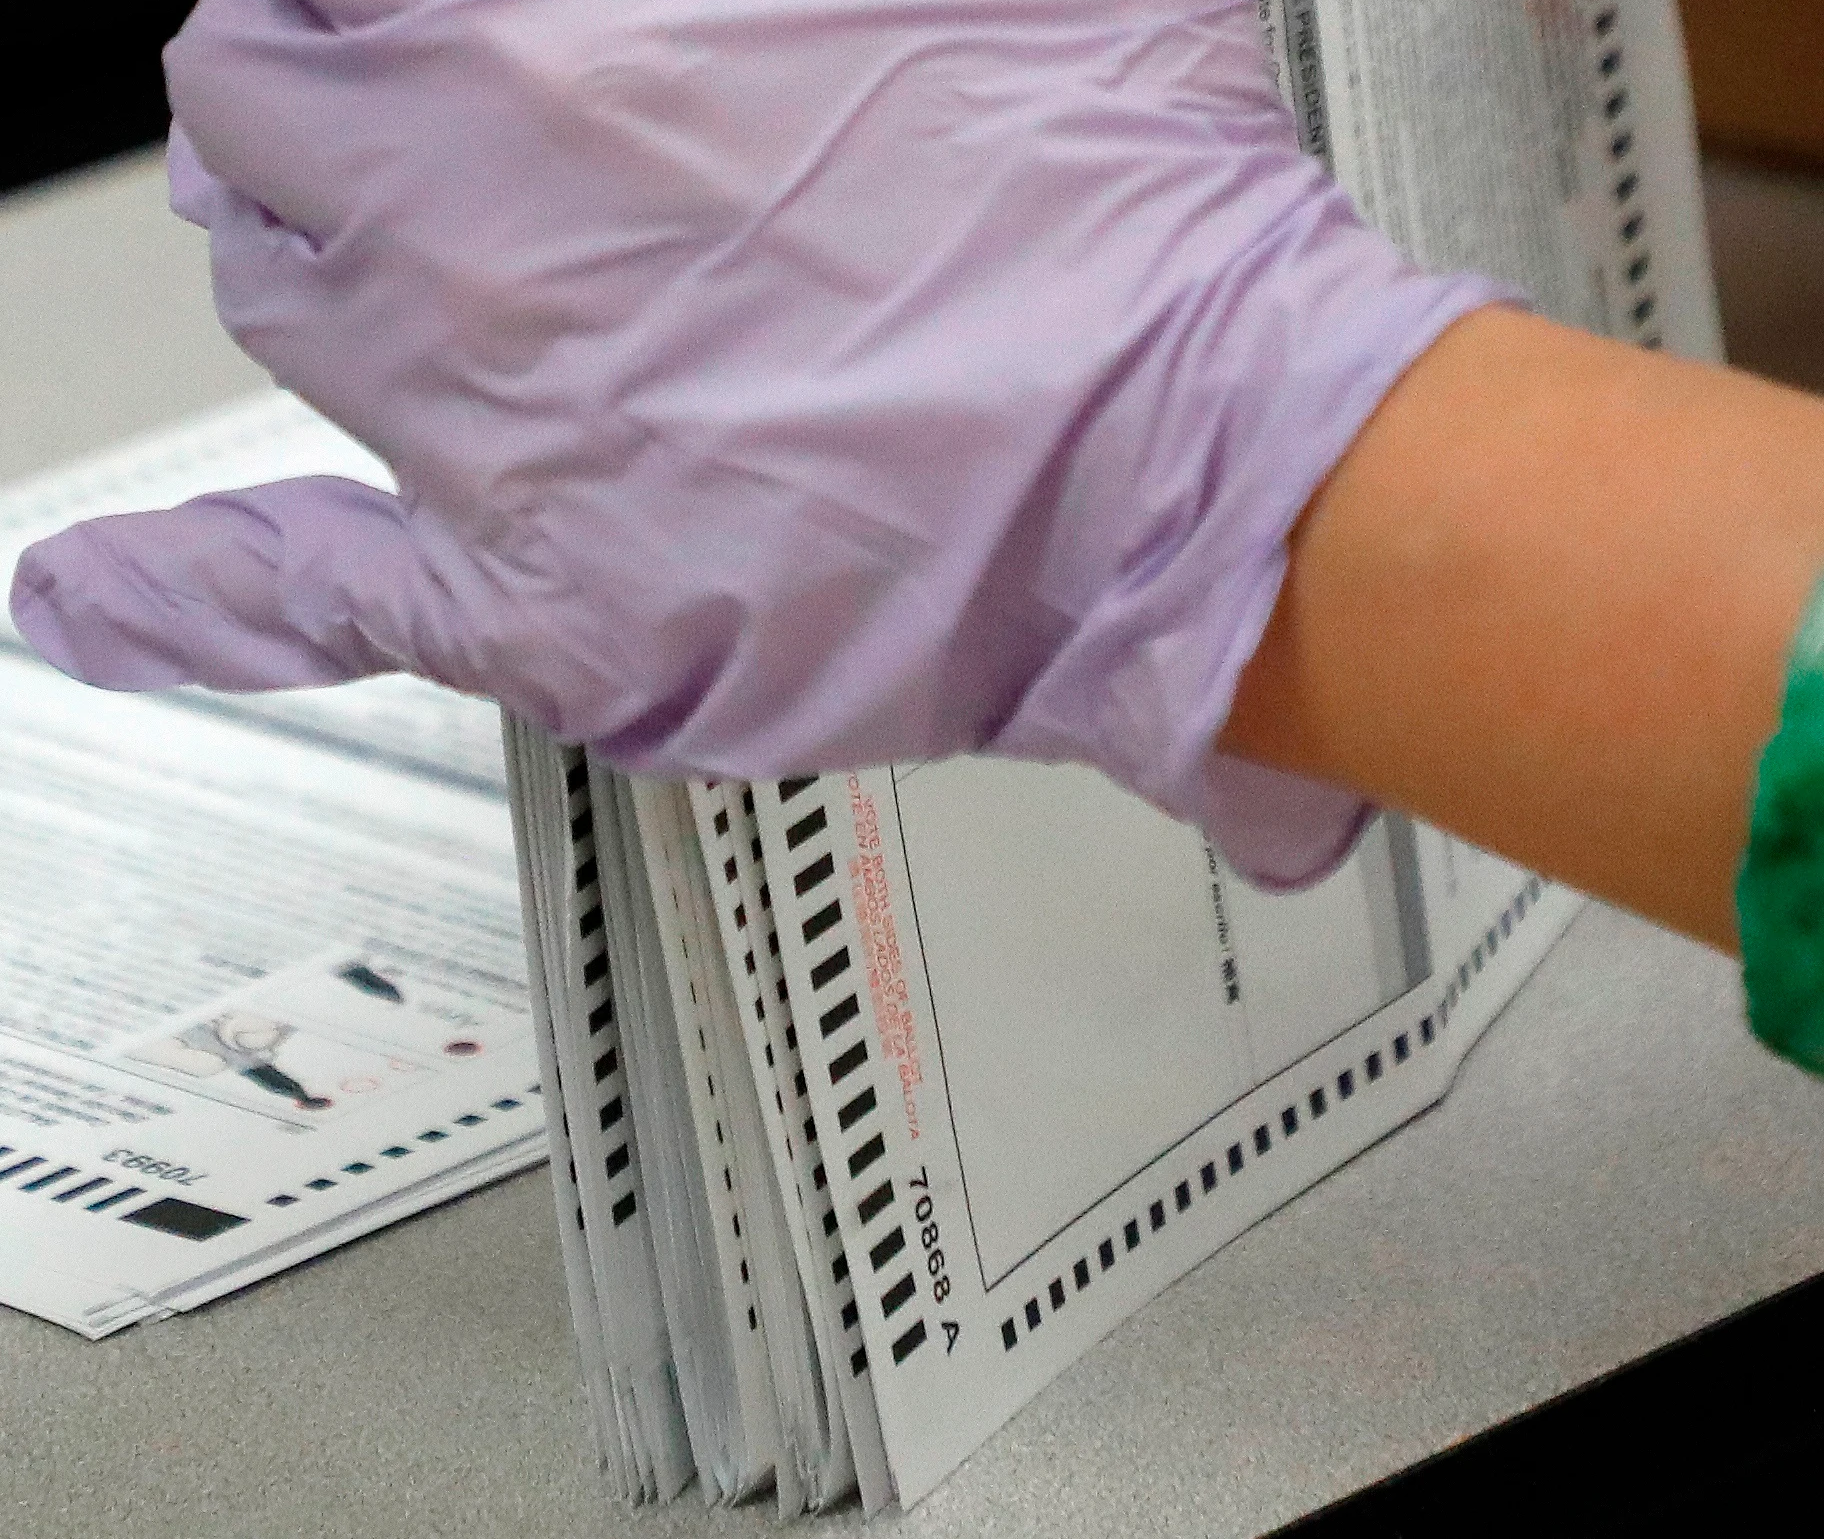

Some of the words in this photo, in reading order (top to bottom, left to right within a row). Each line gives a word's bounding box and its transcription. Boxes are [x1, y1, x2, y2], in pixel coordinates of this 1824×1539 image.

[1296, 11, 1327, 155] PRESIDENT
[909, 1166, 950, 1304] 70868
[941, 1321, 960, 1356] A
